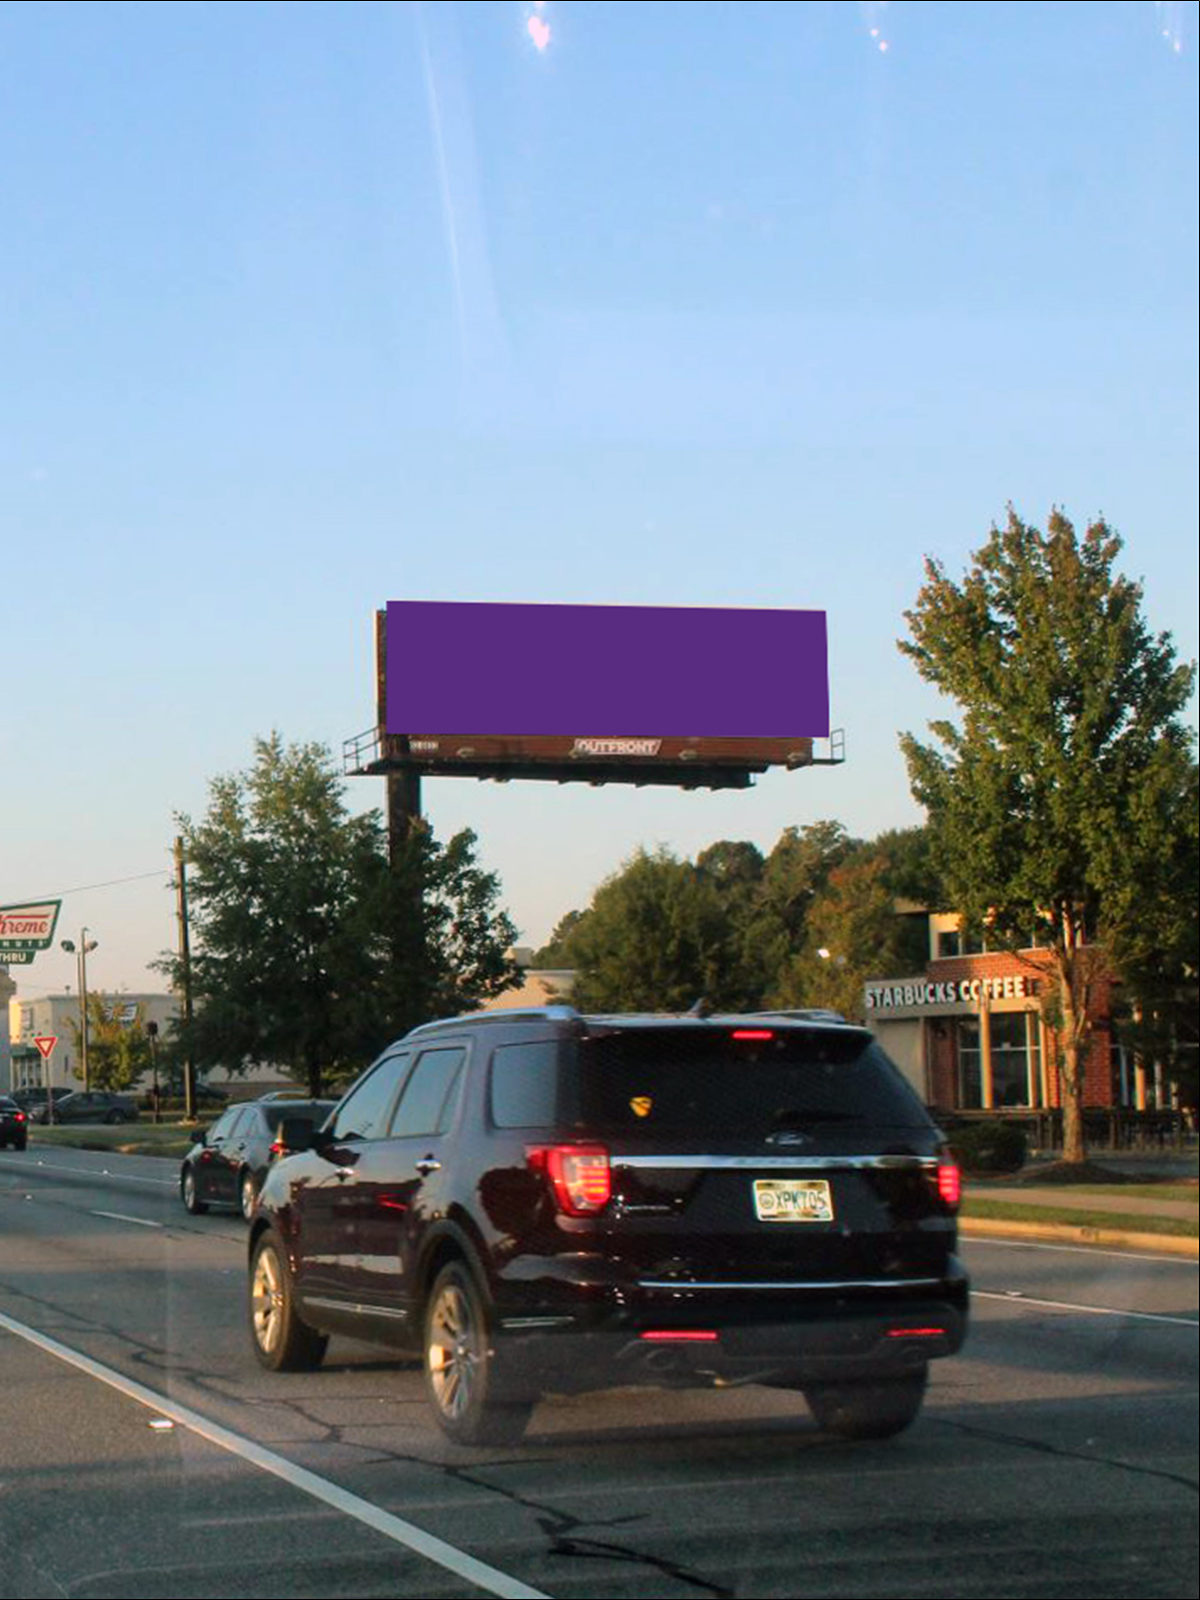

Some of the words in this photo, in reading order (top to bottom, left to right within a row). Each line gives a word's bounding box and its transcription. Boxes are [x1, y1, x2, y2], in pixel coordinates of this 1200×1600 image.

[579, 740, 657, 754] OUTFRONT
[865, 982, 956, 1008] STARBUCKS
[959, 976, 1025, 1001] COFFEE
